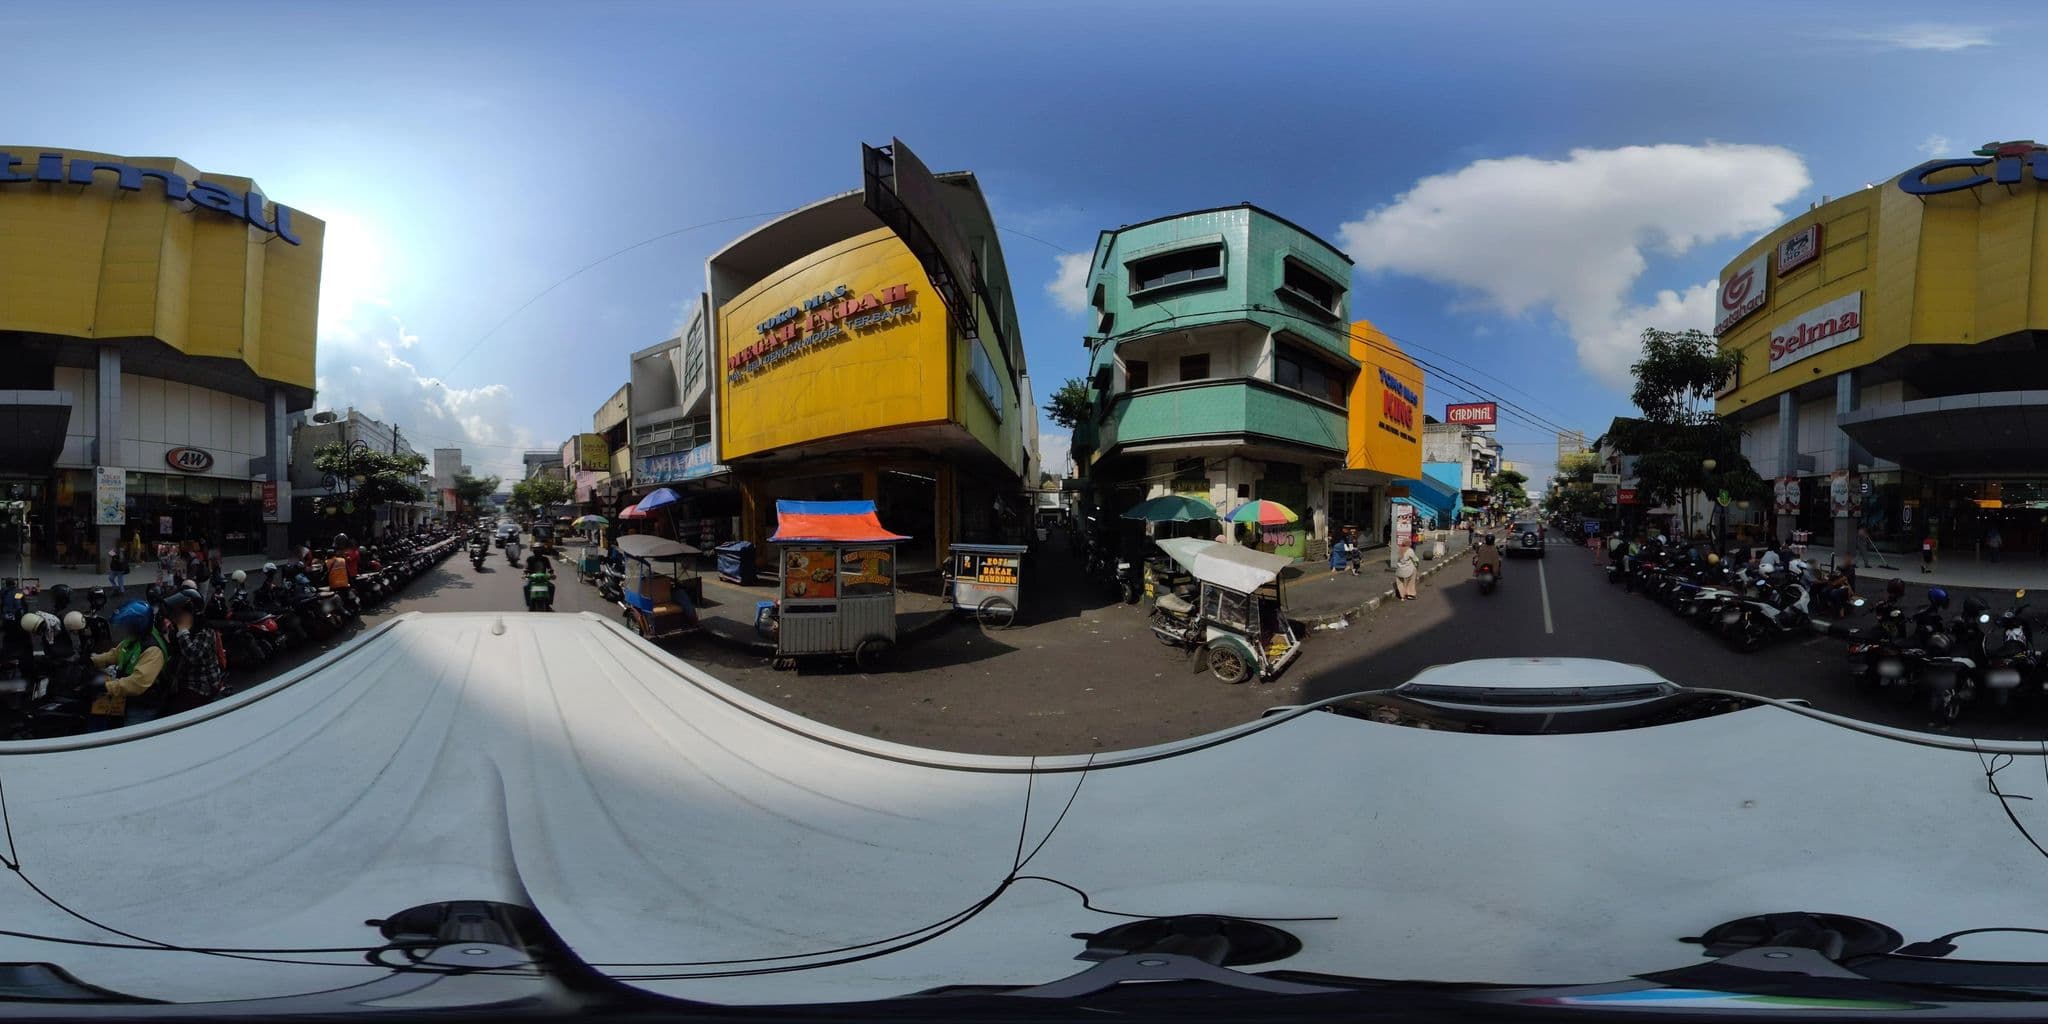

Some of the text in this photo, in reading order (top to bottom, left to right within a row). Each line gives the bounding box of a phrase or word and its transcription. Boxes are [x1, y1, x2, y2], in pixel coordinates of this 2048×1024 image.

[727, 283, 909, 370] MEGAH INDAH
[756, 284, 847, 334] TOKO MAS
[803, 326, 842, 346] MODEL
[847, 303, 913, 330] TERBARU
[1713, 288, 1766, 337] matahari
[1769, 311, 1860, 362] Selma
[1383, 389, 1413, 431] KING
[1449, 406, 1492, 422] CARDINAL
